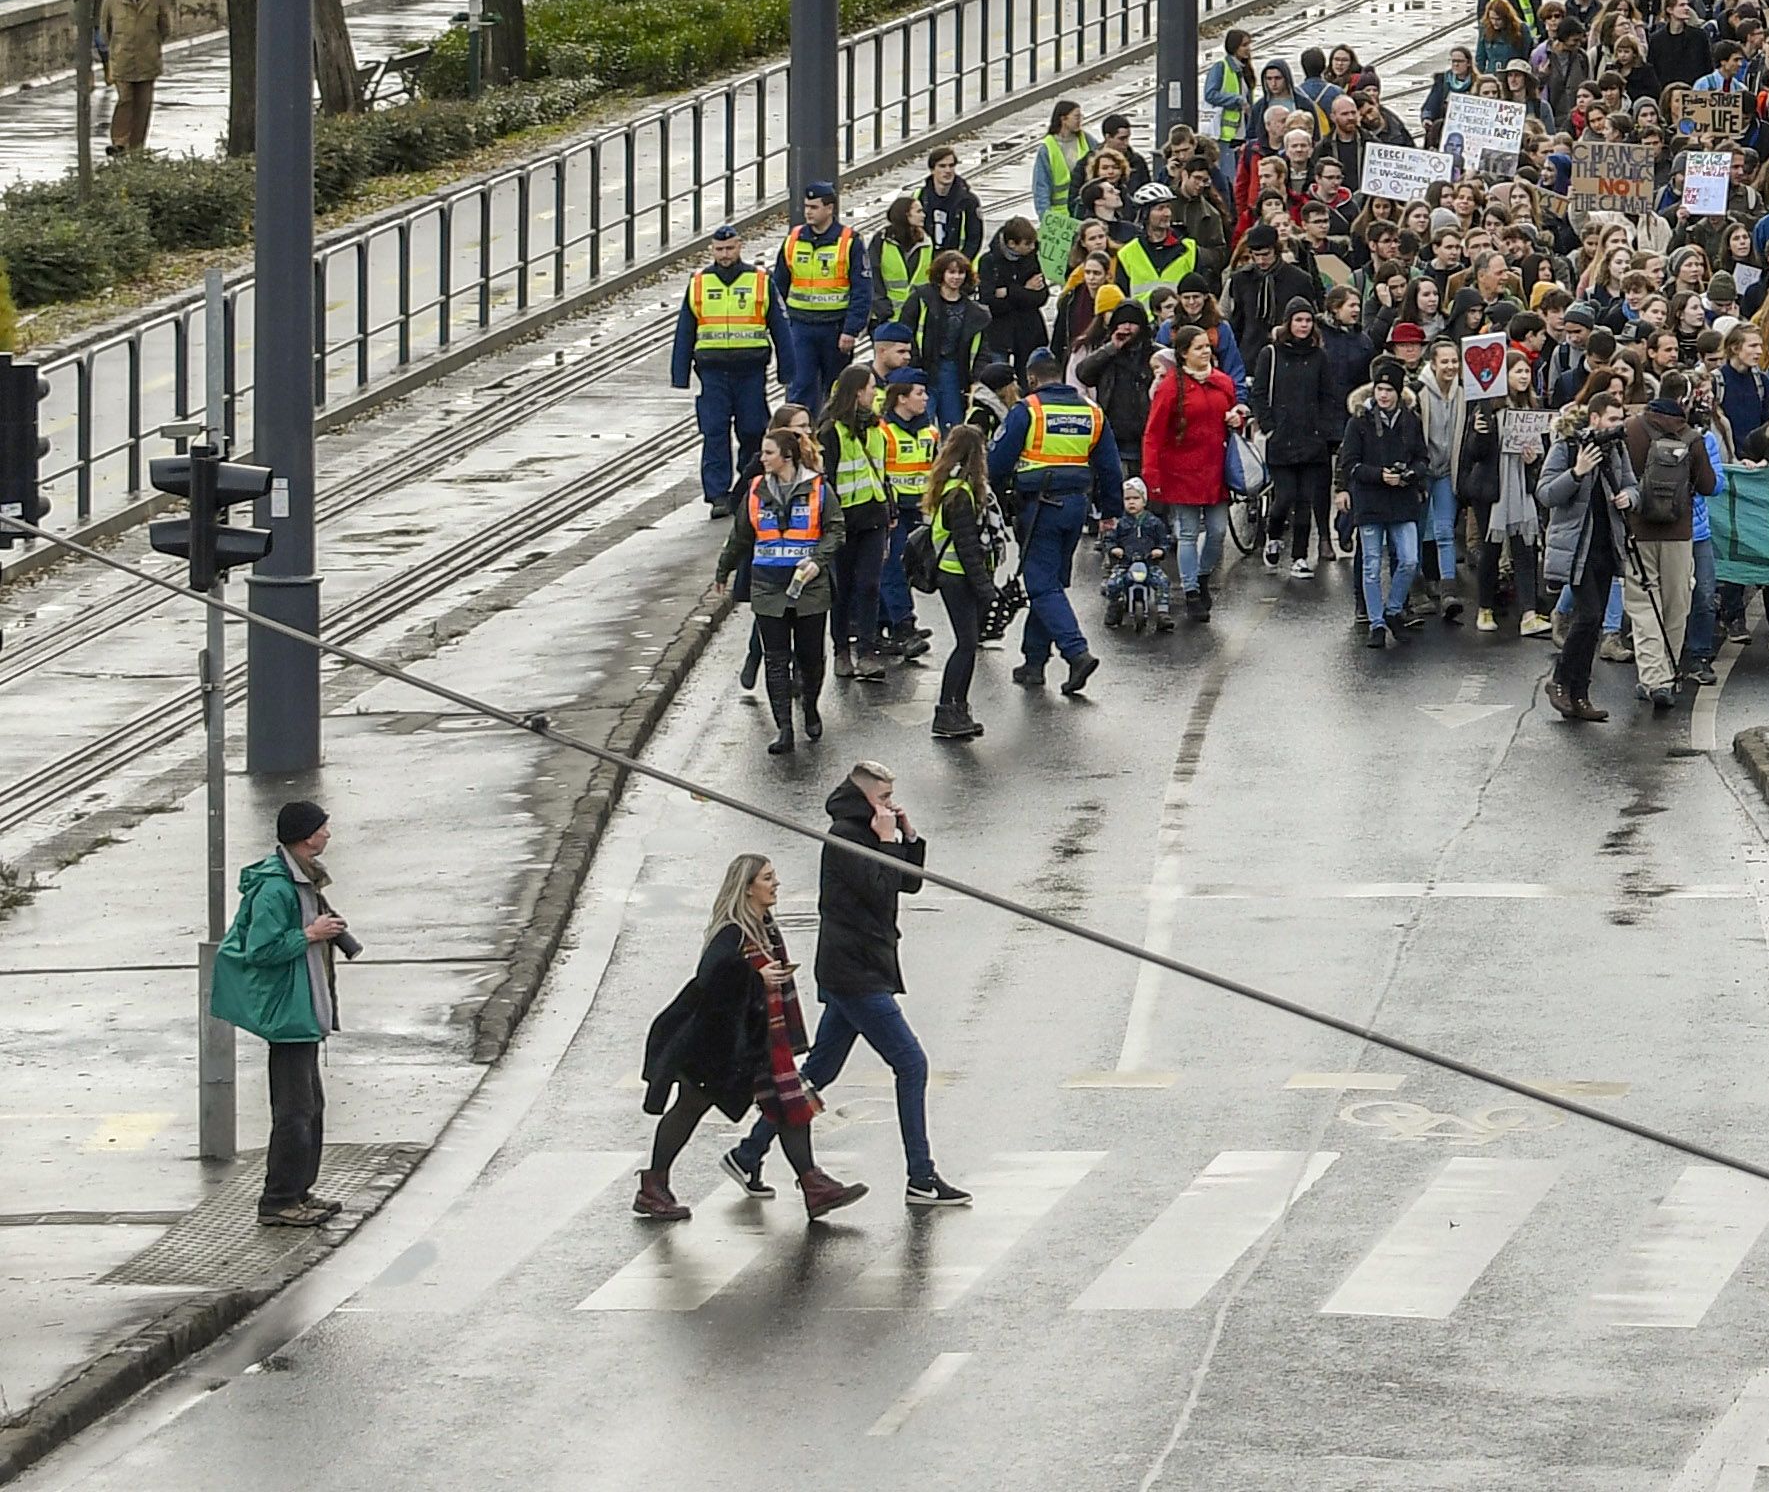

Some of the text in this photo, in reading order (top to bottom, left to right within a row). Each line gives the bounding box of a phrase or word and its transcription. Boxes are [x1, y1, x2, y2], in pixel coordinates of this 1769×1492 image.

[1711, 109, 1740, 133] LIFE
[1572, 143, 1655, 163] CHANGE
[1572, 161, 1655, 181] THE POLITICS
[1598, 178, 1643, 196] NOT
[1572, 194, 1655, 213] THE CLIMATE
